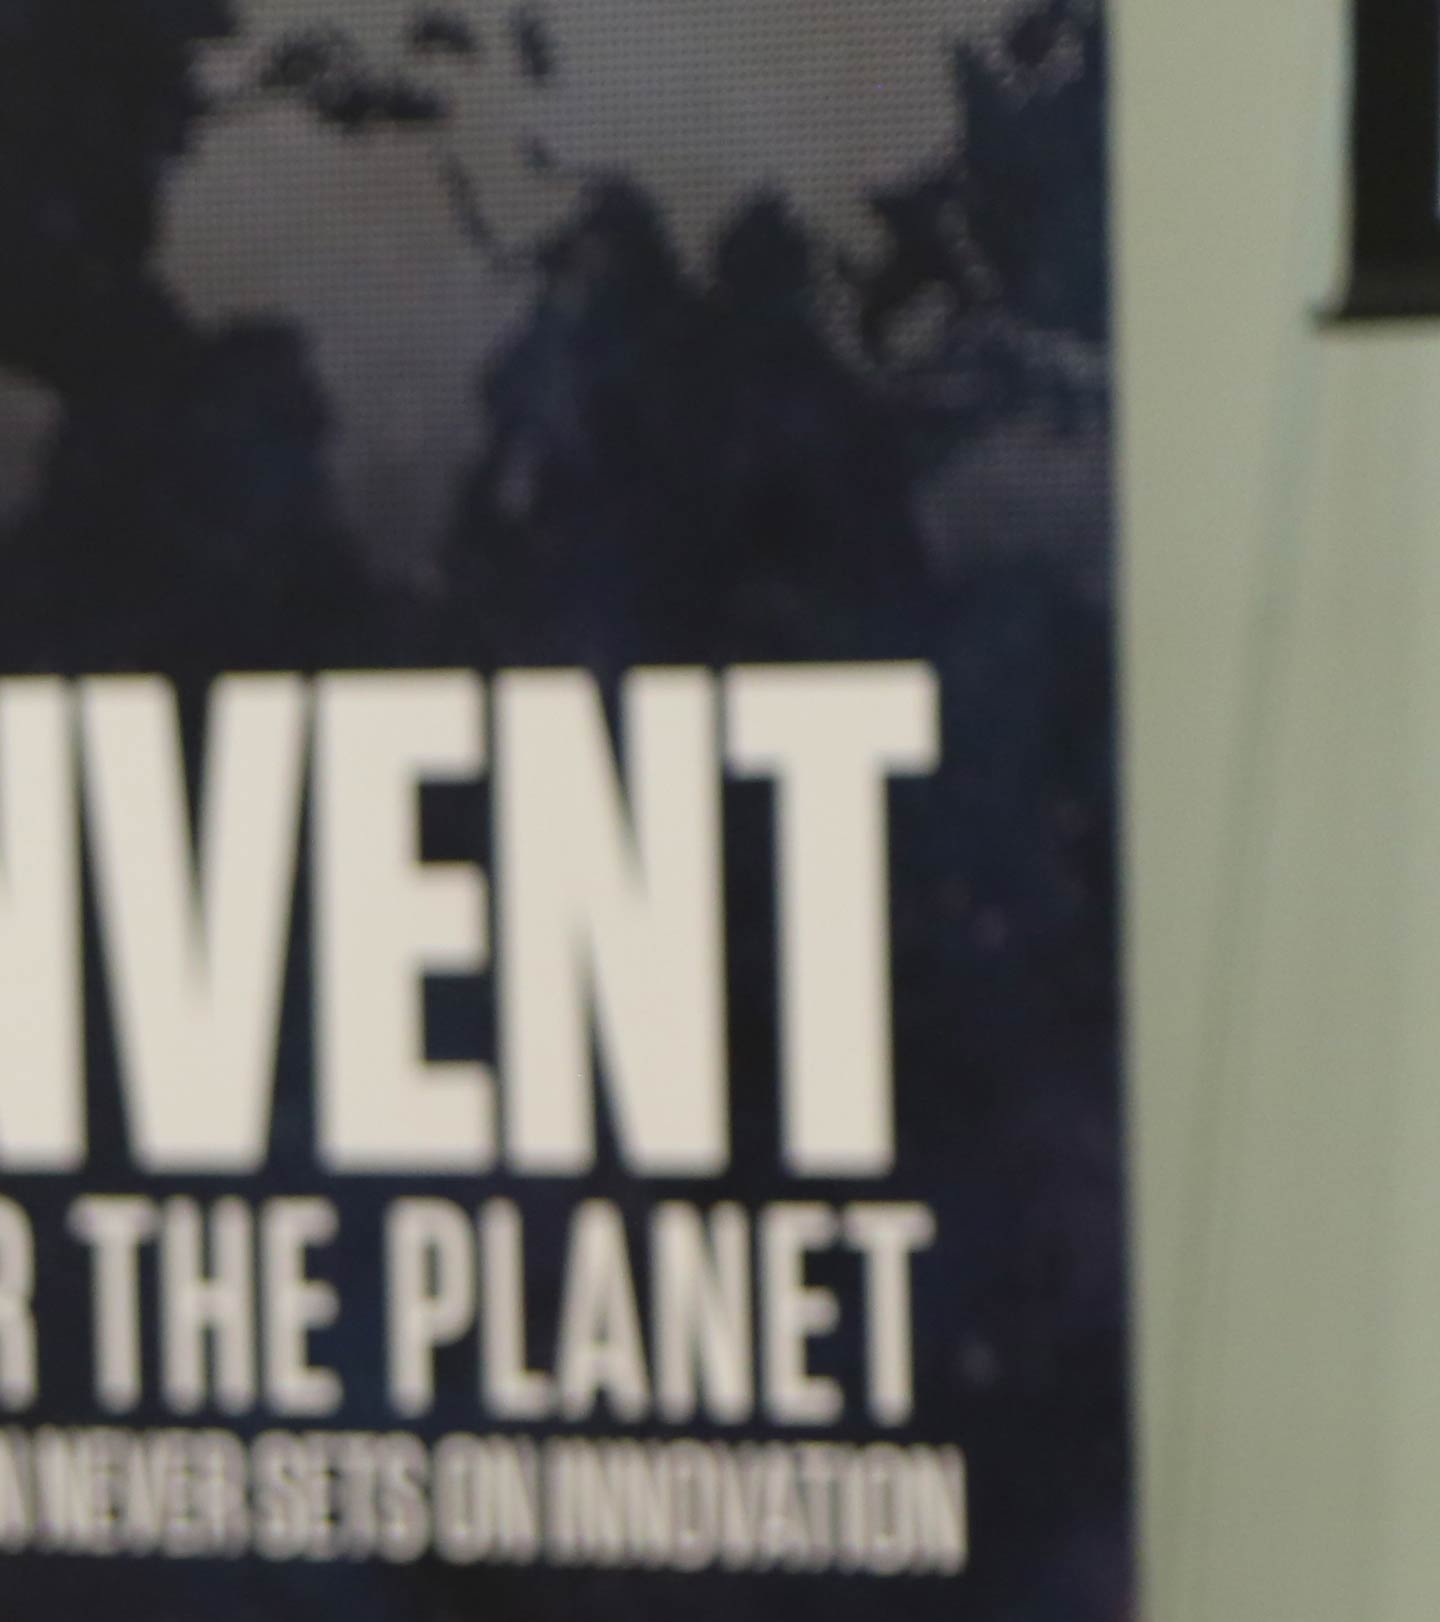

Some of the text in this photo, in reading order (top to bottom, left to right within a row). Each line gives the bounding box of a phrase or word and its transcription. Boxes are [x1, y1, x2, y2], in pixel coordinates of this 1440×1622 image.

[70, 1200, 344, 1417] THE
[385, 1200, 936, 1425] PLANET
[34, 1424, 250, 1560] NEVER
[252, 1430, 433, 1565] SETS
[435, 1430, 541, 1568] ON
[545, 1435, 970, 1577] INNOVATION
